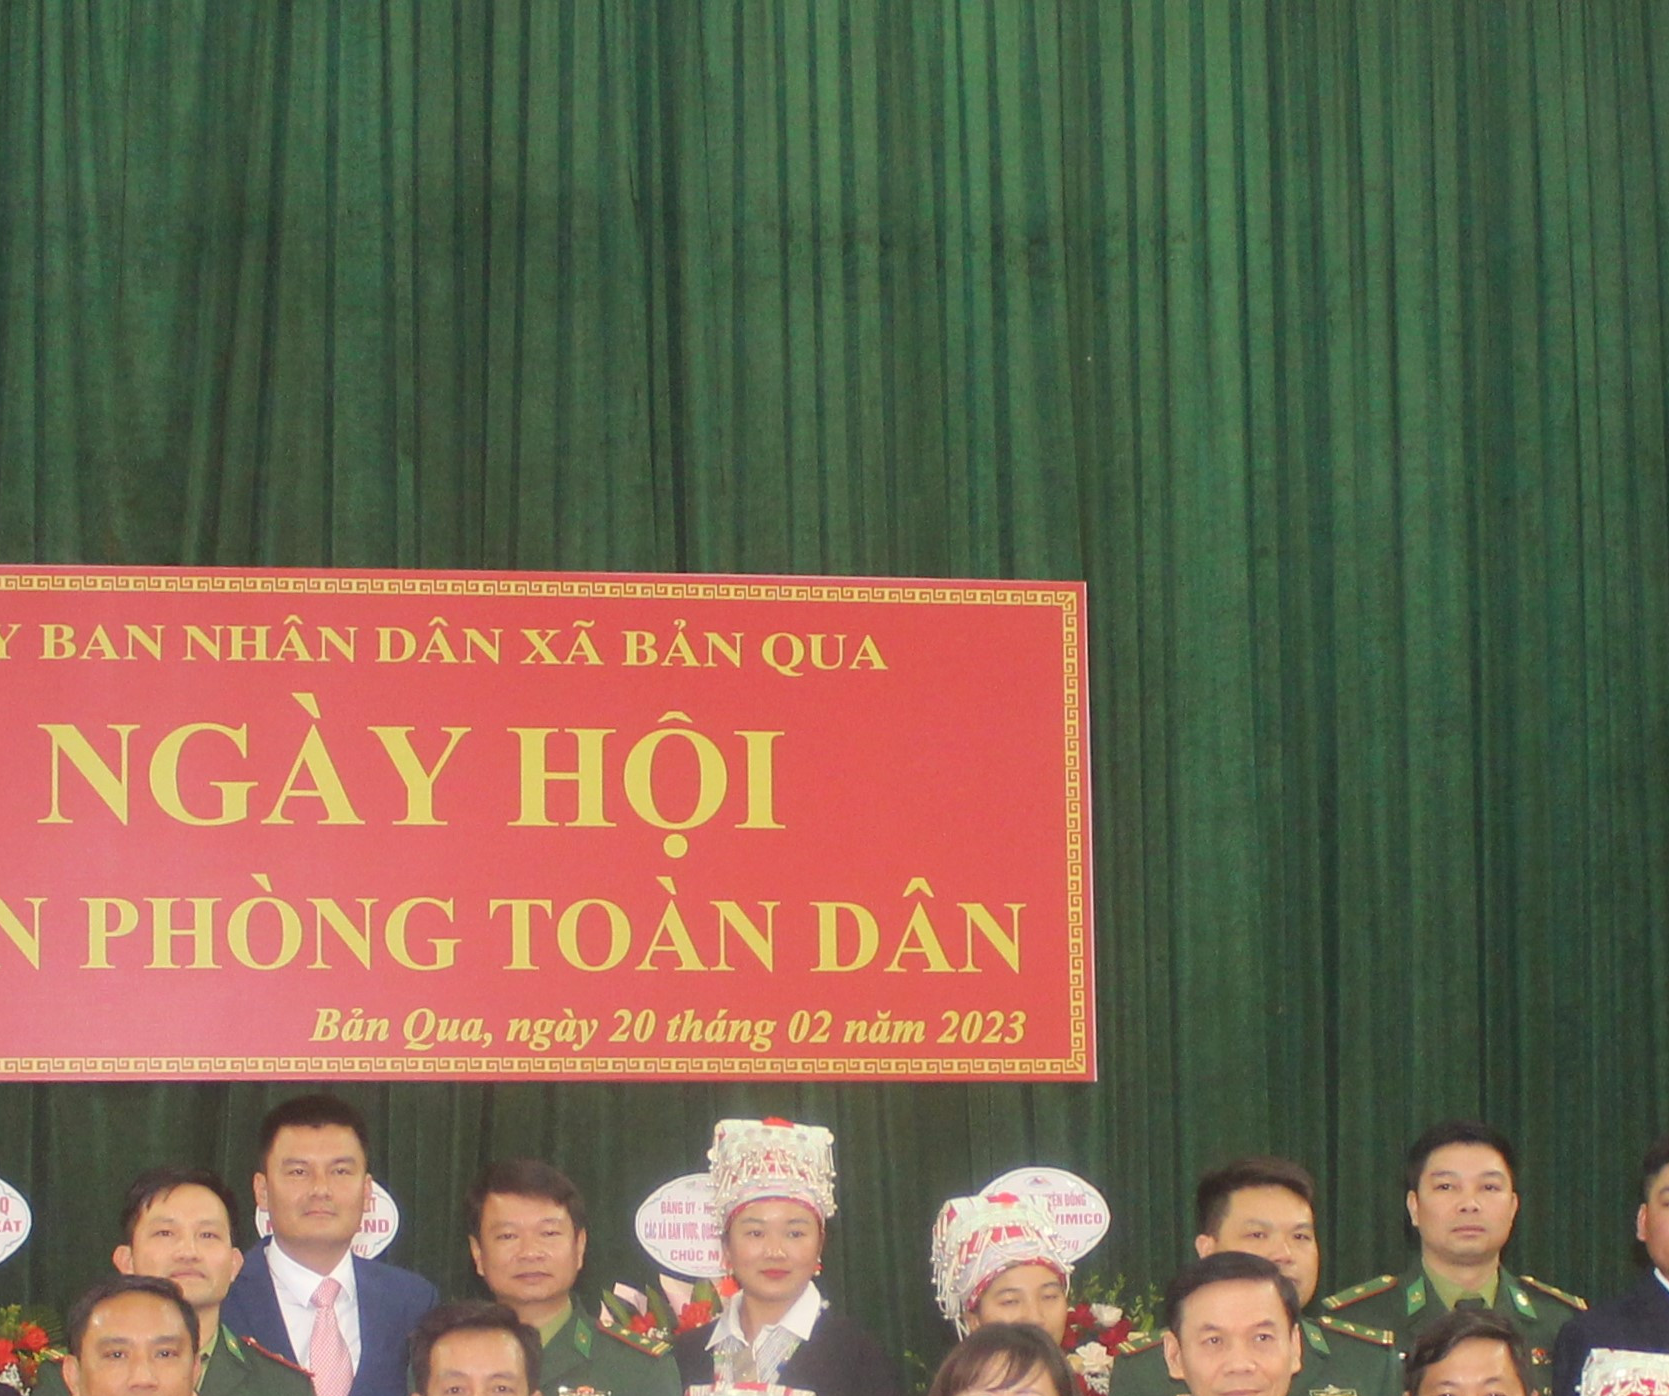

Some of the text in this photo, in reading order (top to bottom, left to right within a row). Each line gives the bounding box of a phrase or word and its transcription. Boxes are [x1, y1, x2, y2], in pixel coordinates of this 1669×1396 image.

[44, 624, 162, 659] BAN
[185, 615, 355, 661] NHÂN
[379, 617, 500, 663] DÂN
[524, 620, 603, 665] XÃ
[625, 620, 742, 667] BẢN
[761, 633, 887, 677] QUA
[41, 692, 784, 858] NGÀY HỘI
[87, 874, 458, 970] PHÒNG
[489, 876, 778, 972] TOÀN
[812, 877, 1024, 973] DÂN
[313, 1008, 1027, 1052] Bản Qua, ngày 20 tháng 02 năm 2023
[670, 1247, 704, 1261] CHÚC
